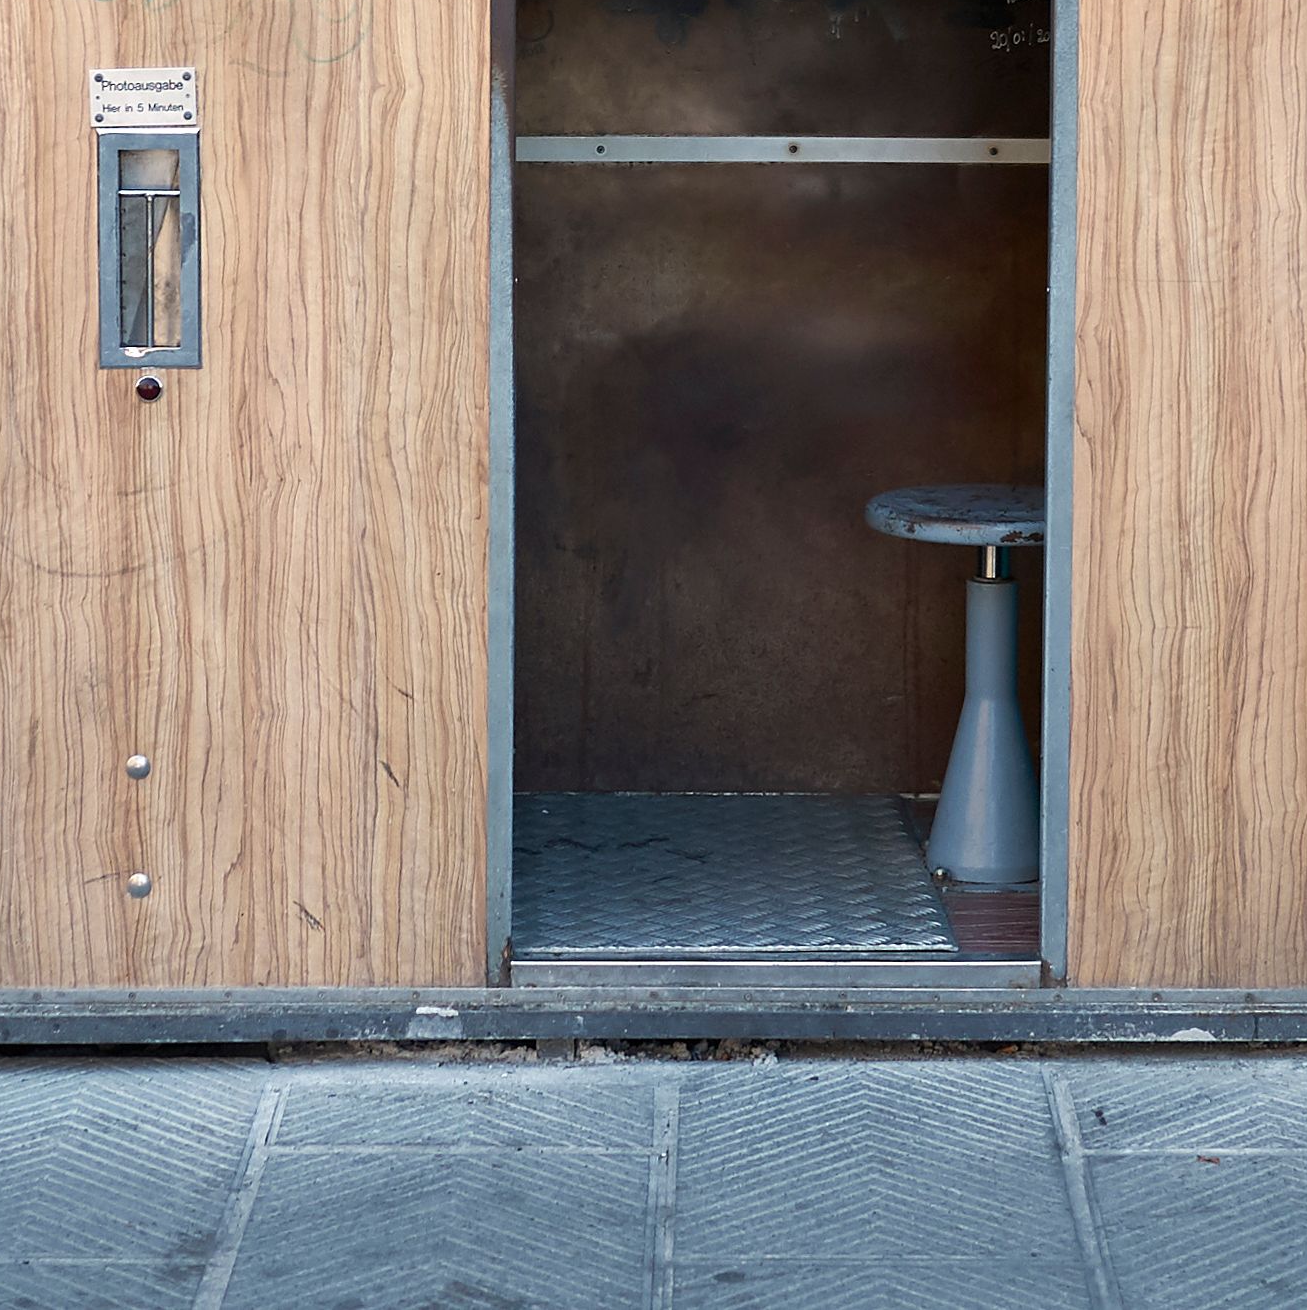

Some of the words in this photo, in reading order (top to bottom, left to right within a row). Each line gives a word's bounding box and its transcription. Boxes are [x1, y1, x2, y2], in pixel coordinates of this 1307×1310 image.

[101, 79, 184, 92] Photoausgabe
[102, 103, 121, 113] Hier
[125, 103, 133, 112] in
[137, 102, 145, 112] 5
[148, 102, 184, 112] Minuten
